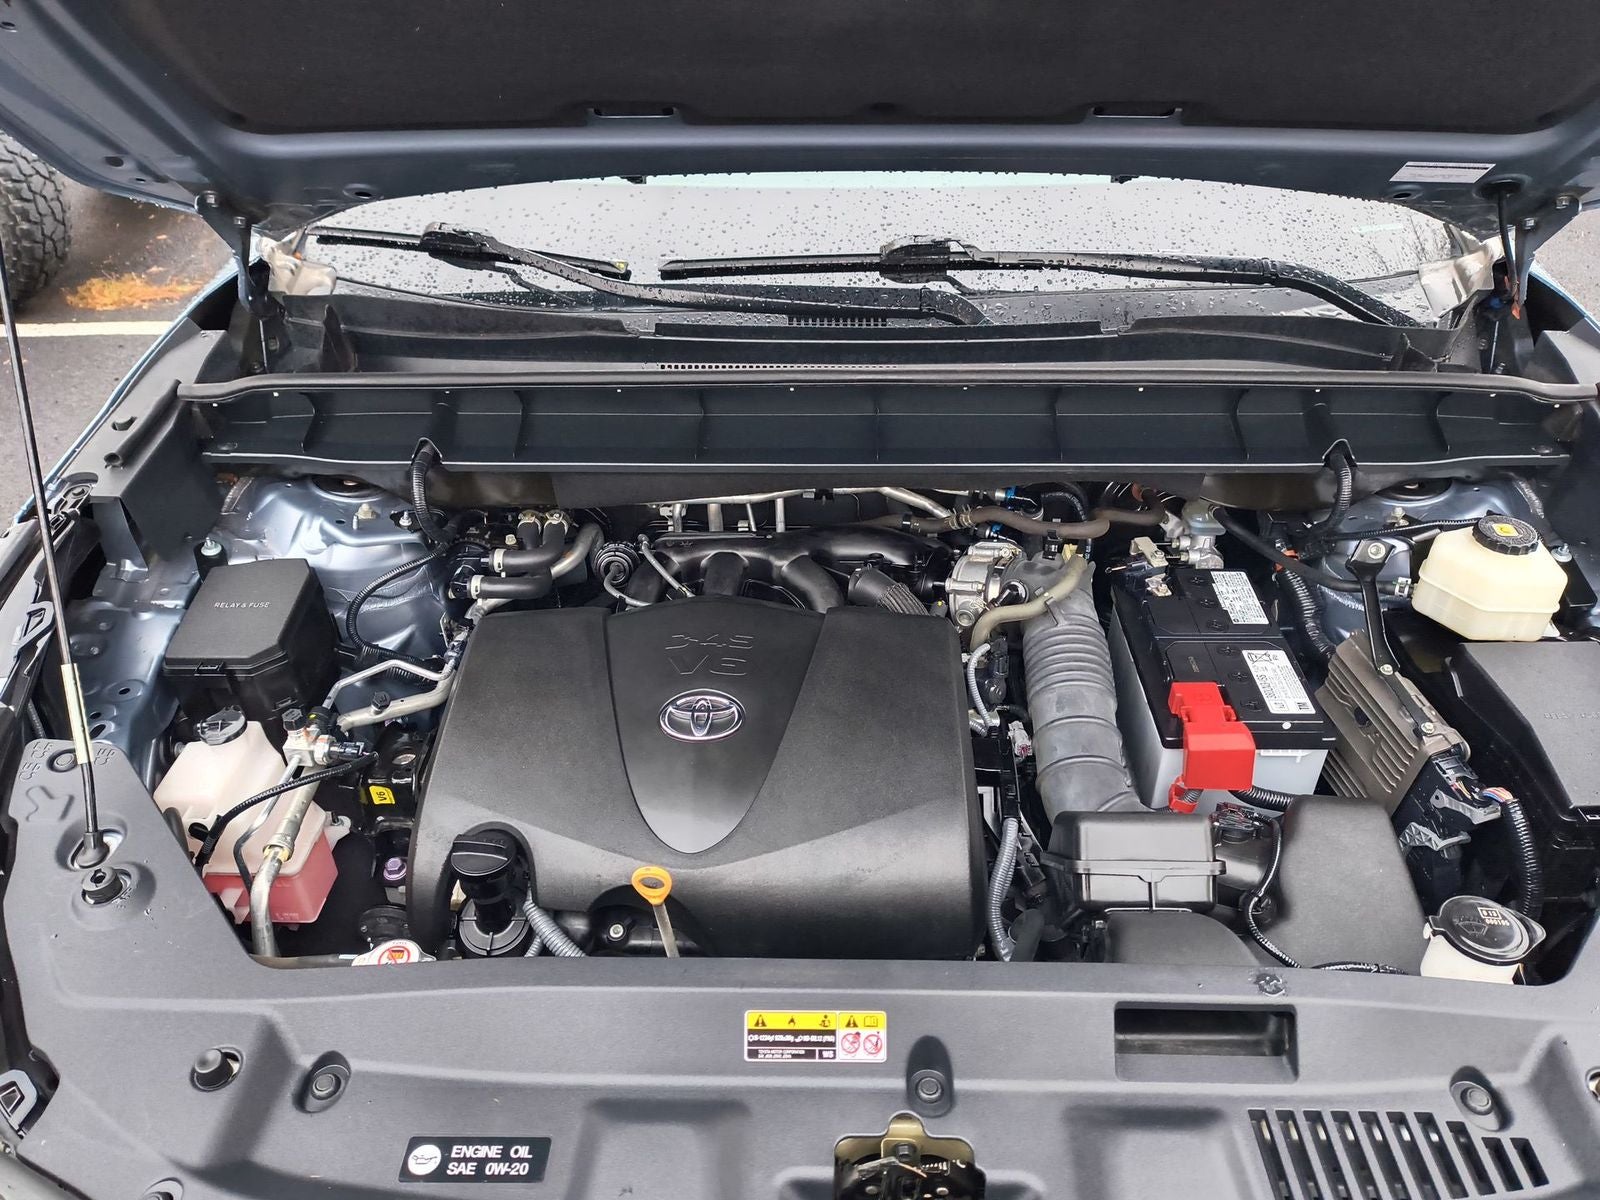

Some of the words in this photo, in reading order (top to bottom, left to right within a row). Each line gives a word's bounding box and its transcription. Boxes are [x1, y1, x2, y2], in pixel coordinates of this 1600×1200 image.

[214, 601, 241, 609] RELAY
[450, 1145, 504, 1159] ENGINE
[509, 1145, 533, 1159] OIL
[446, 1162, 478, 1176] SAE
[485, 1162, 530, 1176] 0W-20
